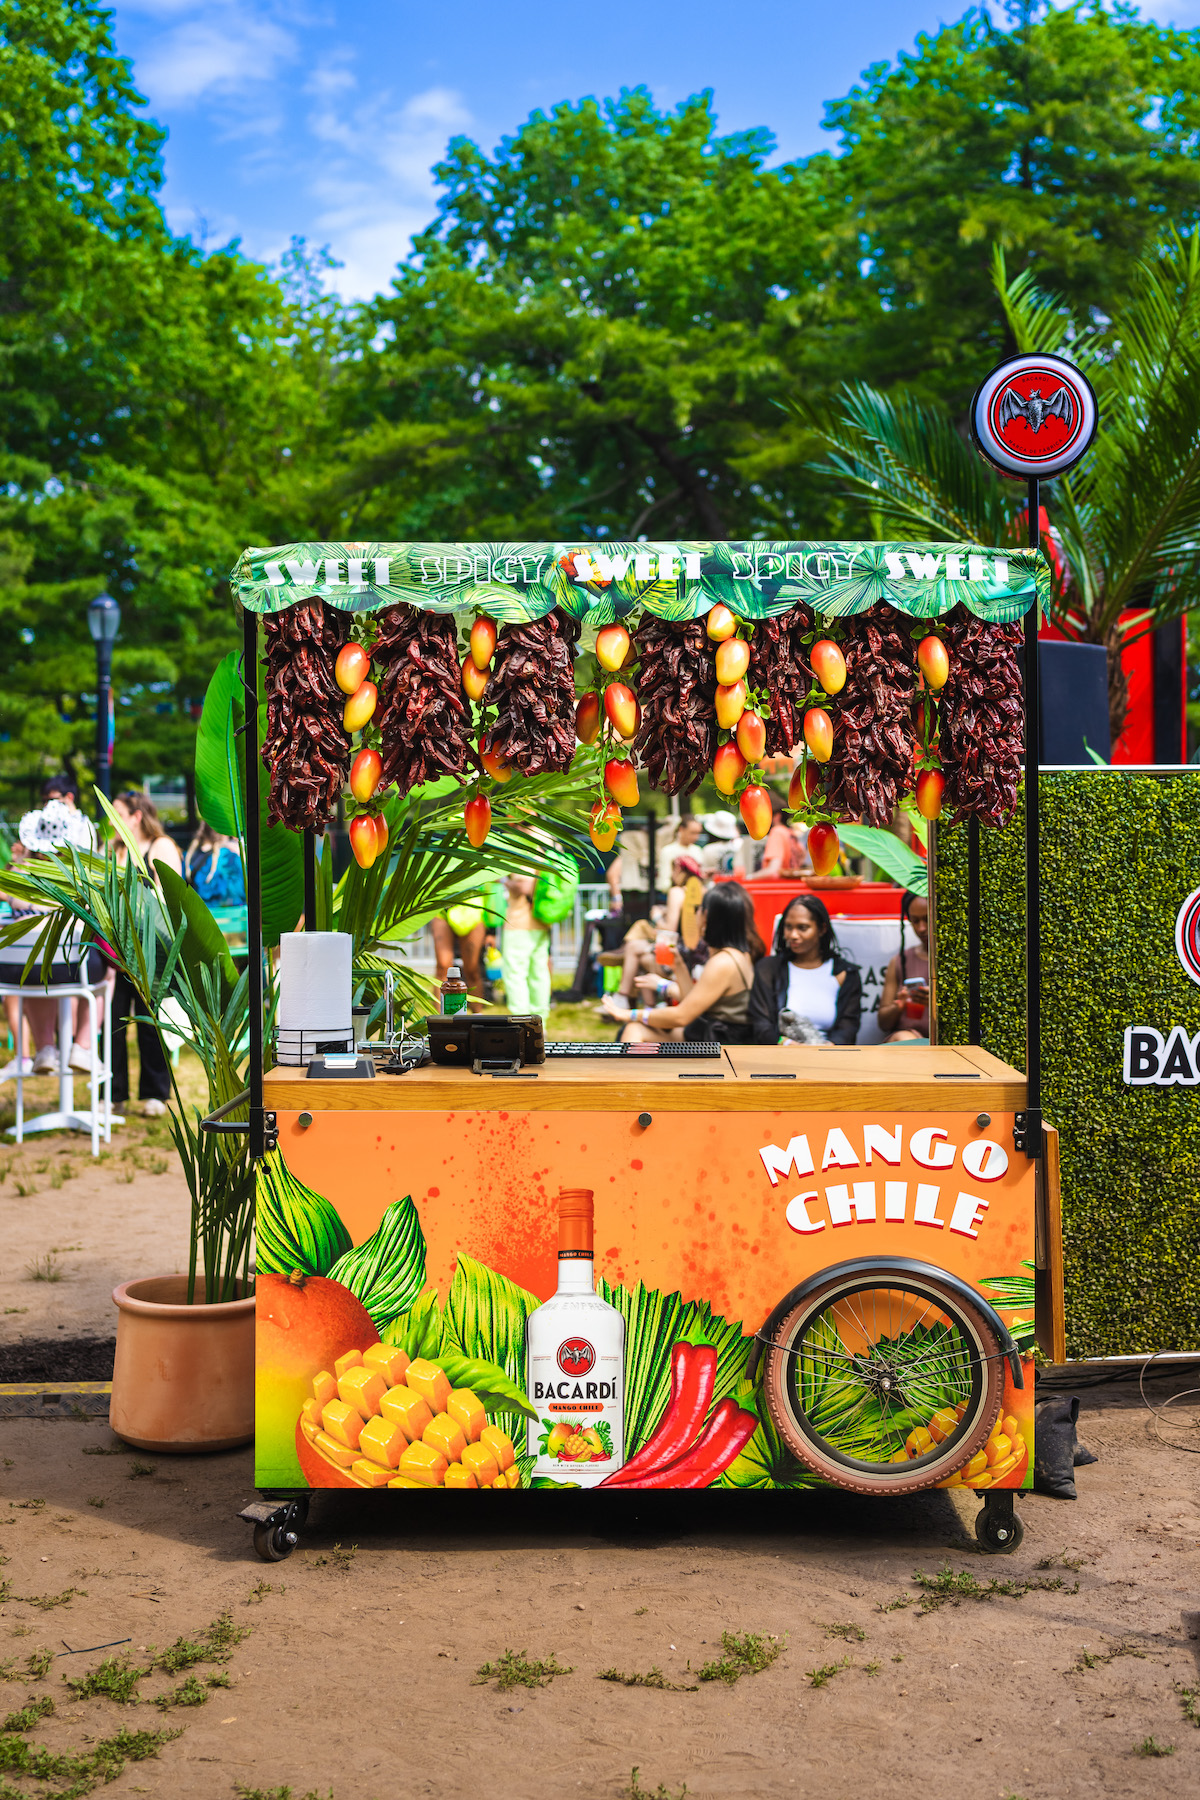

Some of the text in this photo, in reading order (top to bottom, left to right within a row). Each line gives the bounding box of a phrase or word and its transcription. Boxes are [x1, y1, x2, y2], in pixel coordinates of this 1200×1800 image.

[1008, 439, 1027, 452] MARCA
[263, 552, 1013, 586] SWEET SPICY SWEET SPICY SWEET
[1129, 1032, 1200, 1079] BA
[759, 1124, 1009, 1188] MANGO
[785, 1181, 990, 1241] CHILE
[534, 1376, 617, 1400] BACARDÍ
